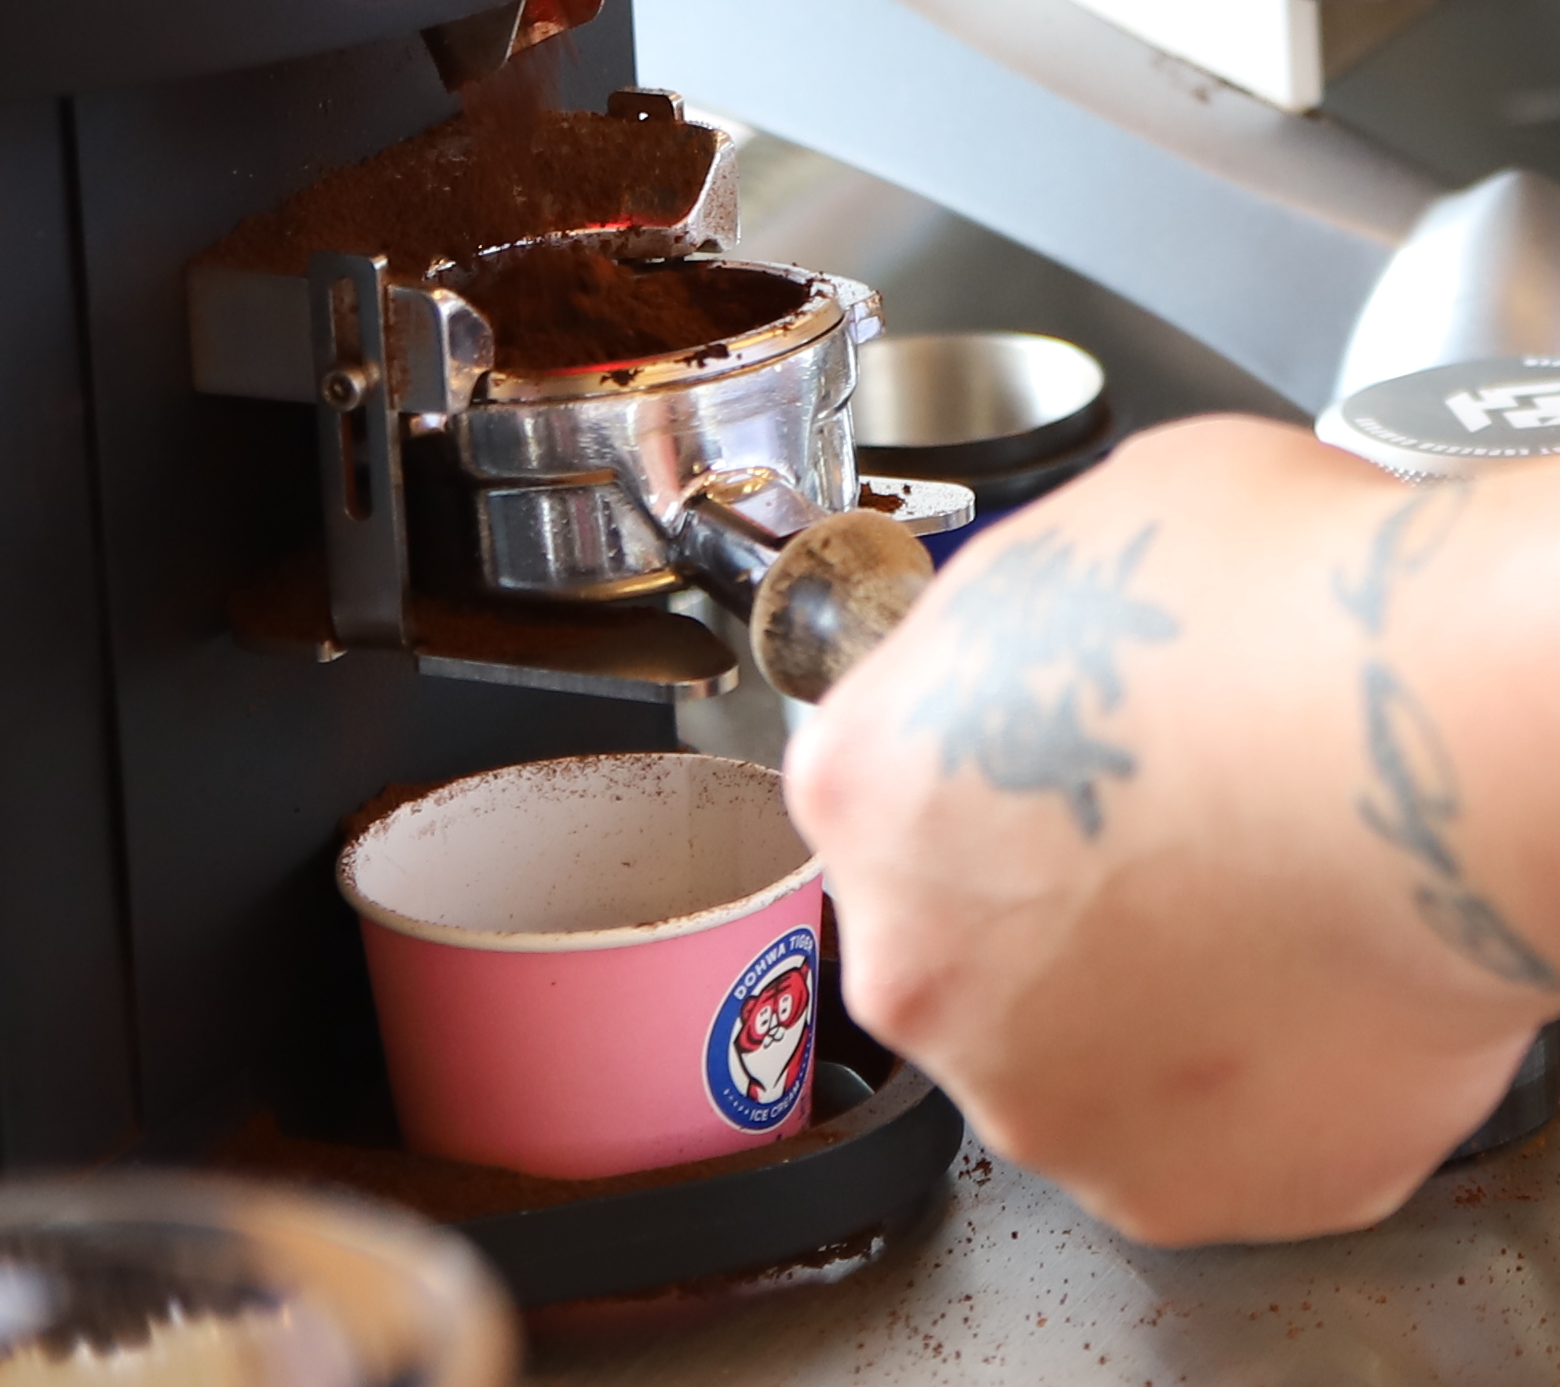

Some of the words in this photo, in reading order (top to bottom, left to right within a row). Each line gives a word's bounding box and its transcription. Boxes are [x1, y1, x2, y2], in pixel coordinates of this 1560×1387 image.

[733, 942, 786, 1000] DOHWA
[789, 933, 814, 955] TIGER
[749, 1109, 769, 1122] ICE
[770, 1080, 800, 1118] CREAM
